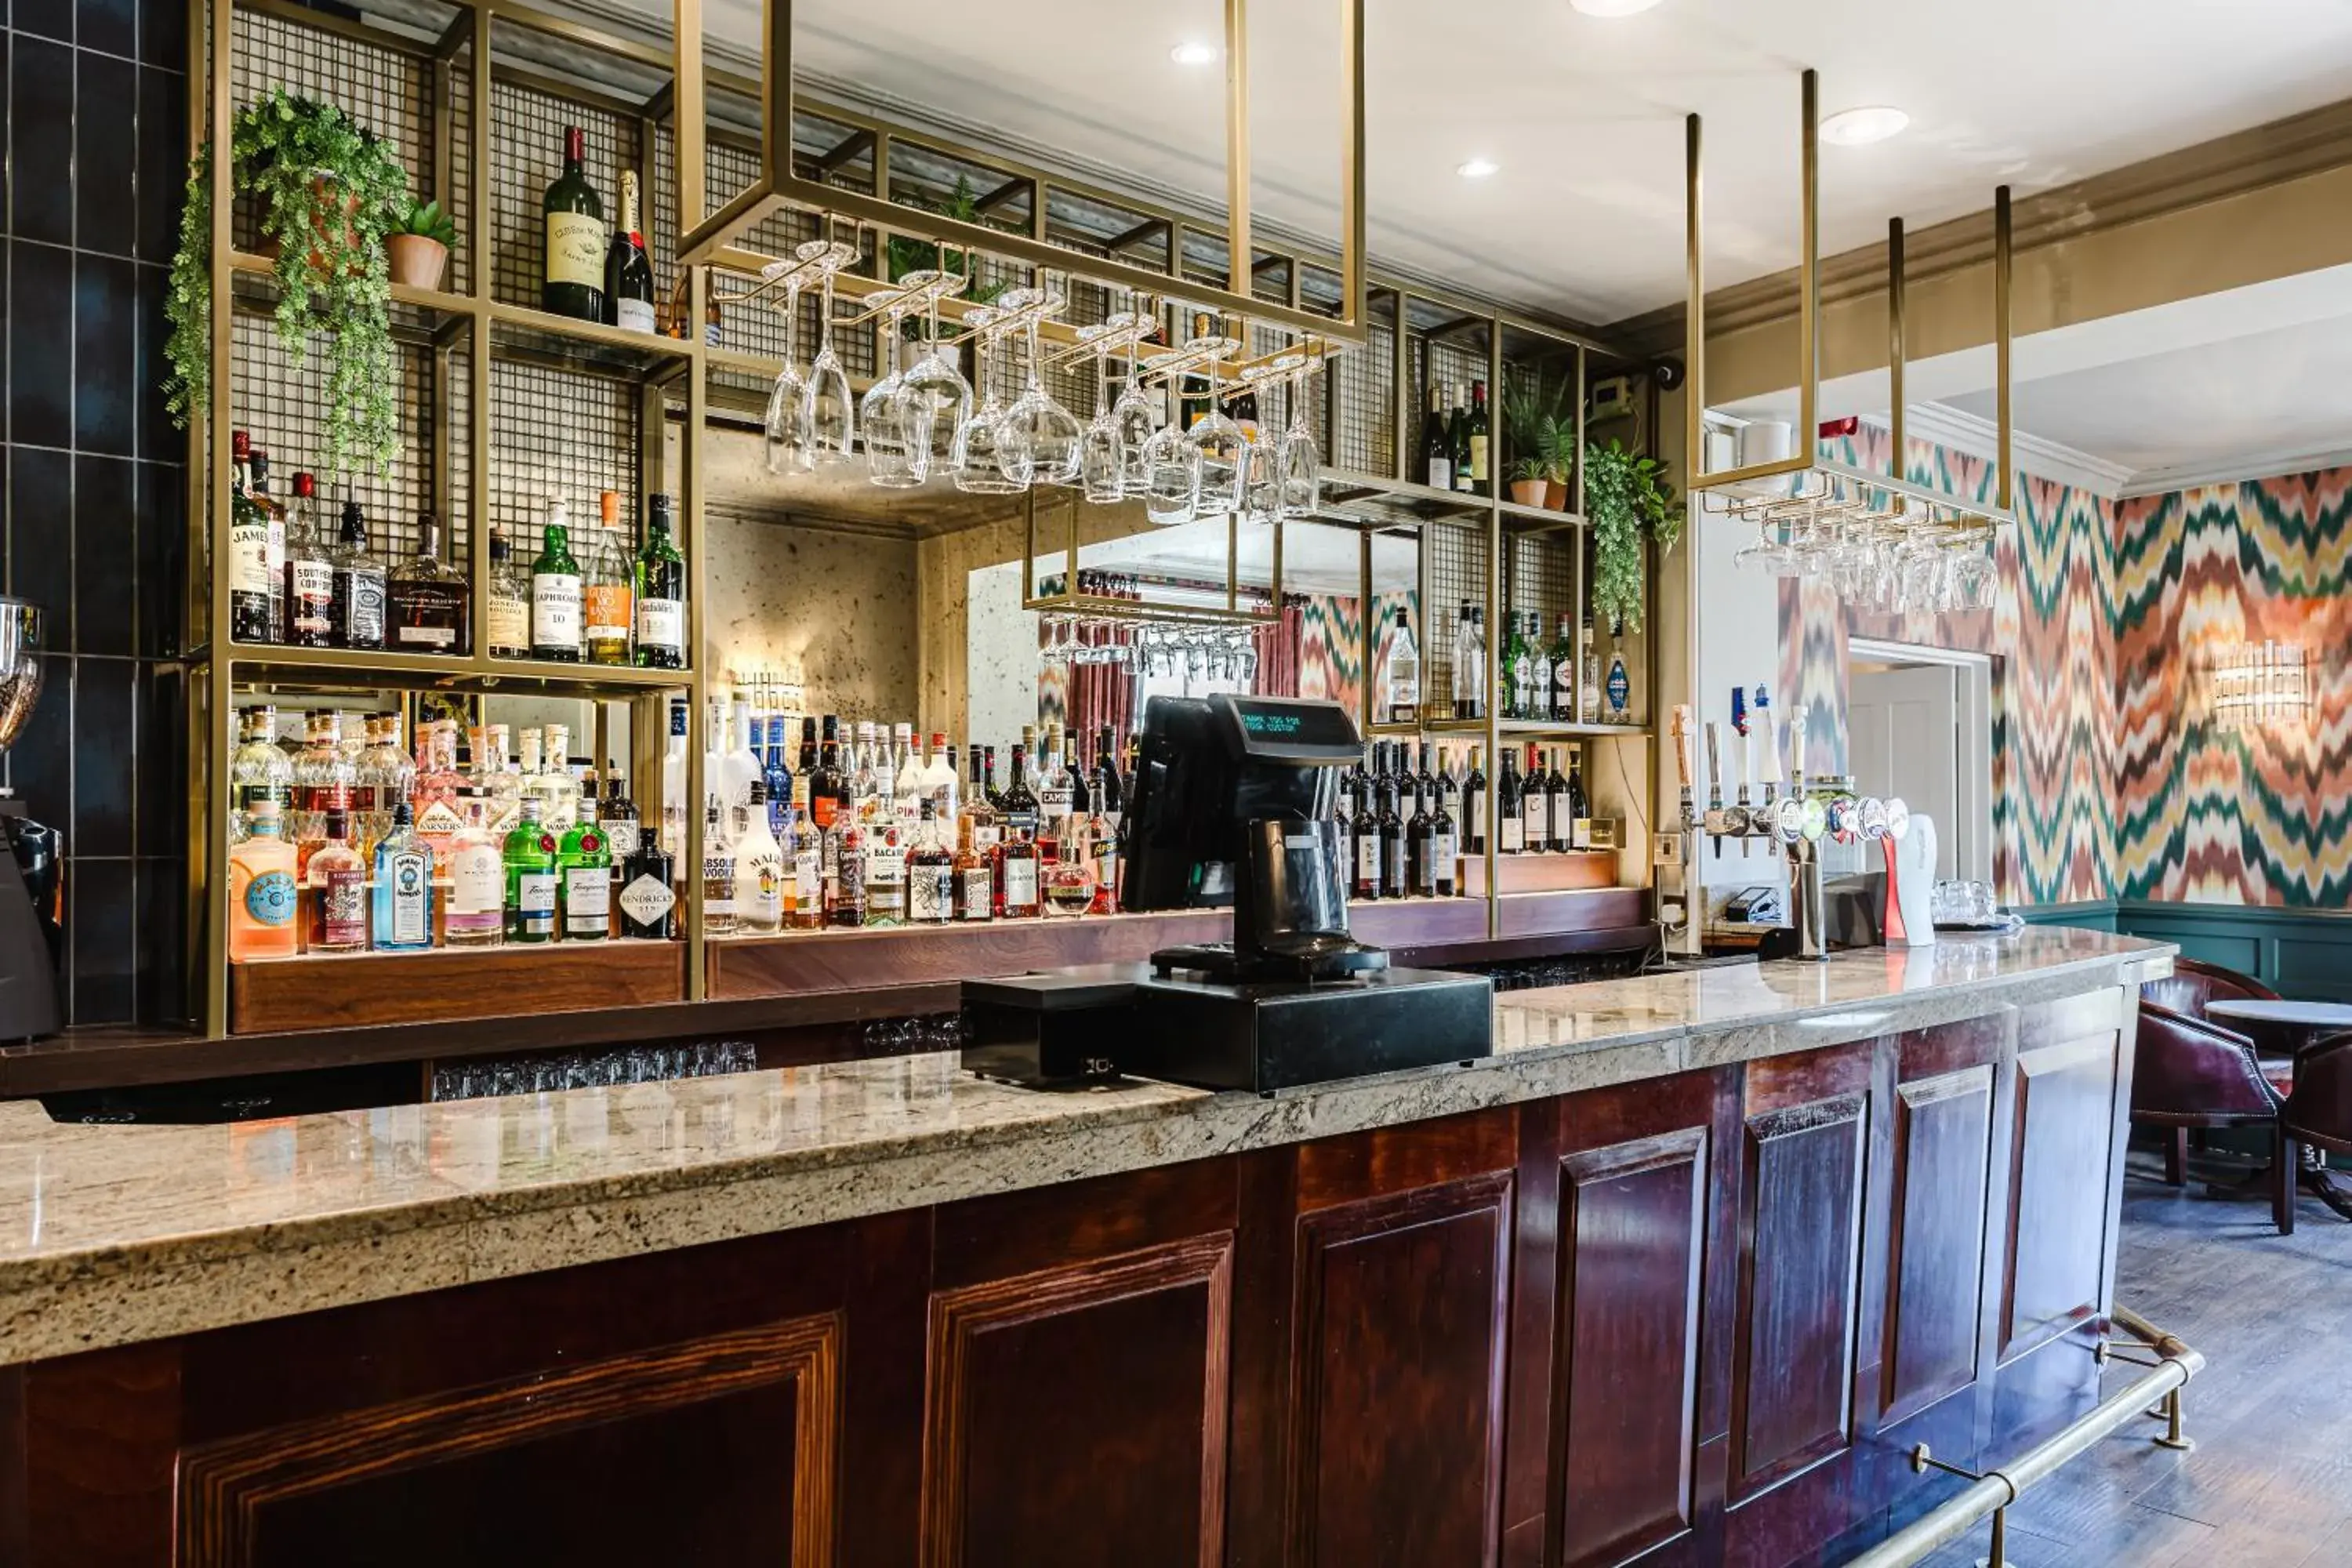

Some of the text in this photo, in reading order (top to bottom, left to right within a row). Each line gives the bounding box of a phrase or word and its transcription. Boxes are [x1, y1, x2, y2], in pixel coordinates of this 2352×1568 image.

[233, 531, 268, 543] JAMES
[553, 613, 565, 623] 10
[704, 858, 736, 868] BSOLUT
